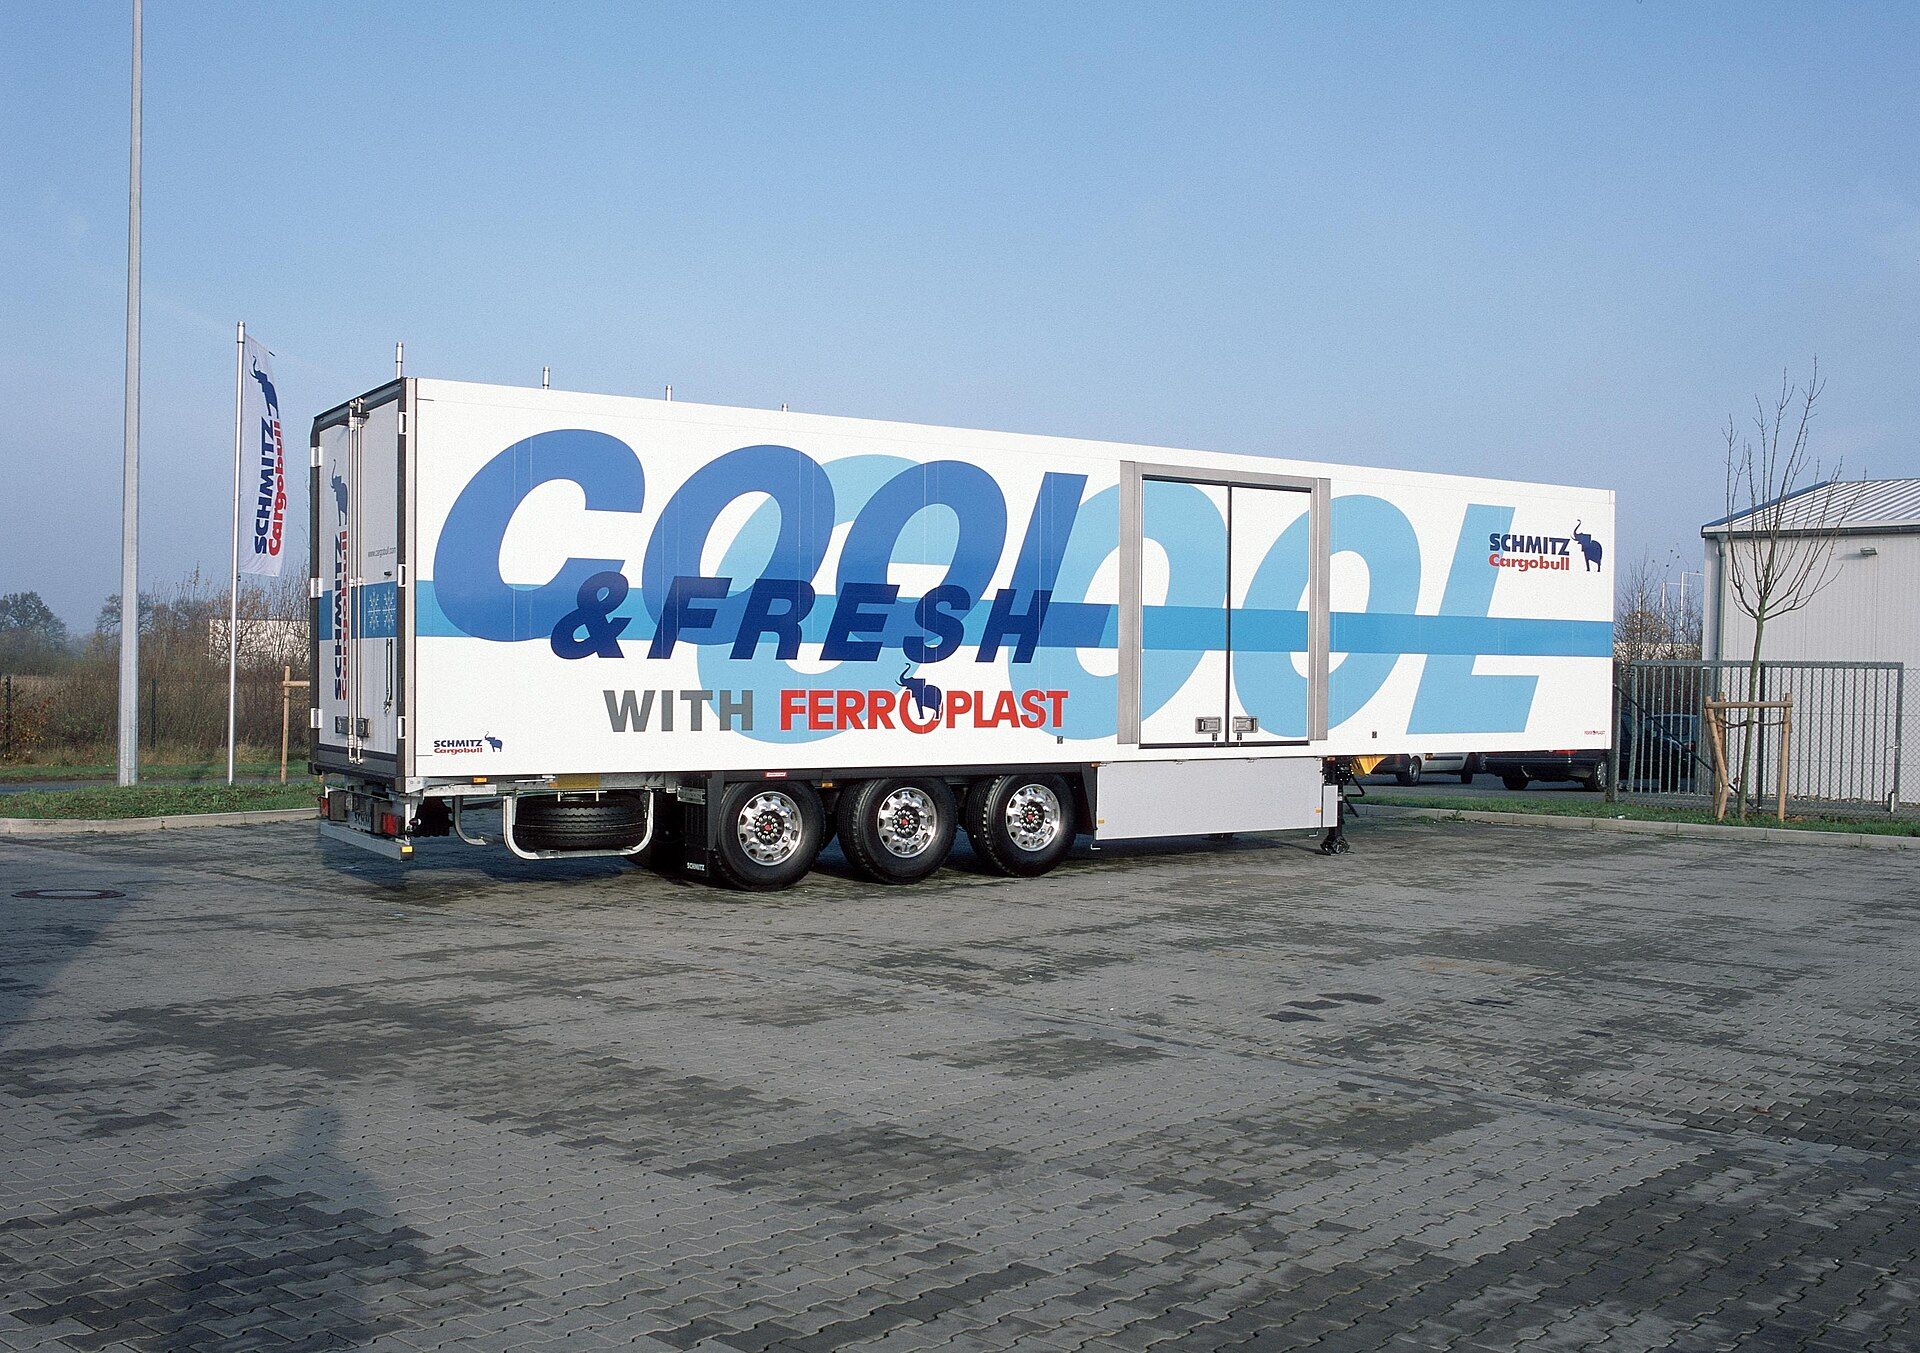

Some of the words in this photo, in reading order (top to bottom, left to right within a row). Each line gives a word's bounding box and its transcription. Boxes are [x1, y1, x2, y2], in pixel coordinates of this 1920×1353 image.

[254, 416, 275, 554] SCHMITZ
[268, 420, 287, 556] Cargobull
[433, 429, 1115, 648] COOL
[1489, 533, 1570, 555] SCHMITZ
[1488, 553, 1570, 572] Cargobull
[550, 571, 632, 660] &
[646, 576, 1051, 663] FRESH
[603, 689, 753, 732] WITH
[780, 689, 1069, 734] FERROPLAST
[433, 739, 483, 748] SCHMITZ
[433, 747, 483, 755] Cargobull
